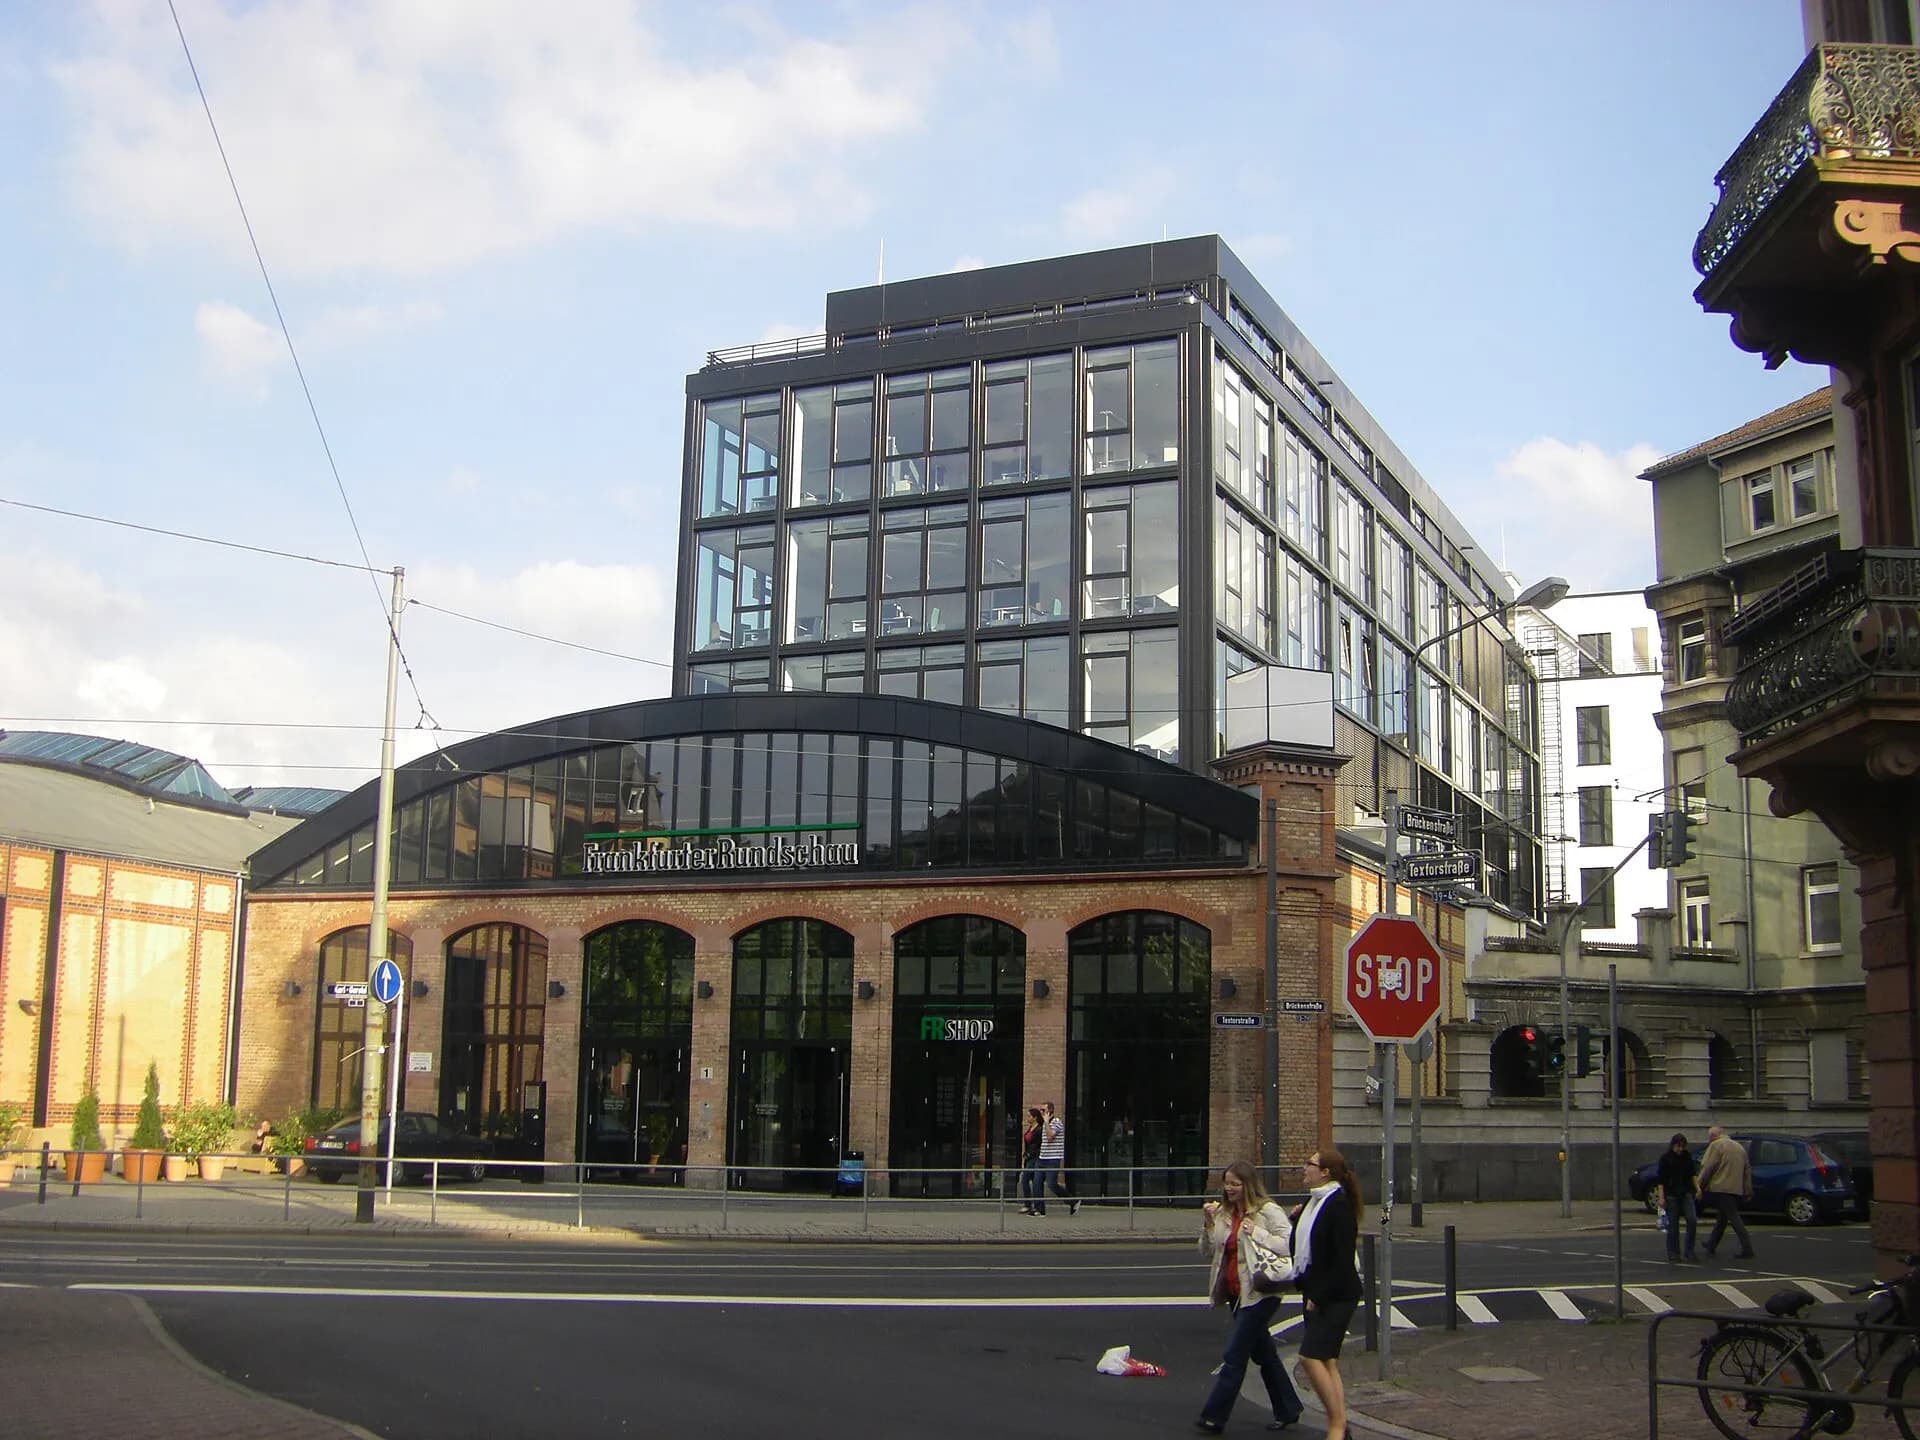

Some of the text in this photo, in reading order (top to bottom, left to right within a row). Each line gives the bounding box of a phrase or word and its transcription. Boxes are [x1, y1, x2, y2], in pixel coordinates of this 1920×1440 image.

[1406, 813, 1453, 835] Brückenstraße
[1409, 860, 1470, 877] Textorstraße
[1355, 953, 1433, 1002] STOP
